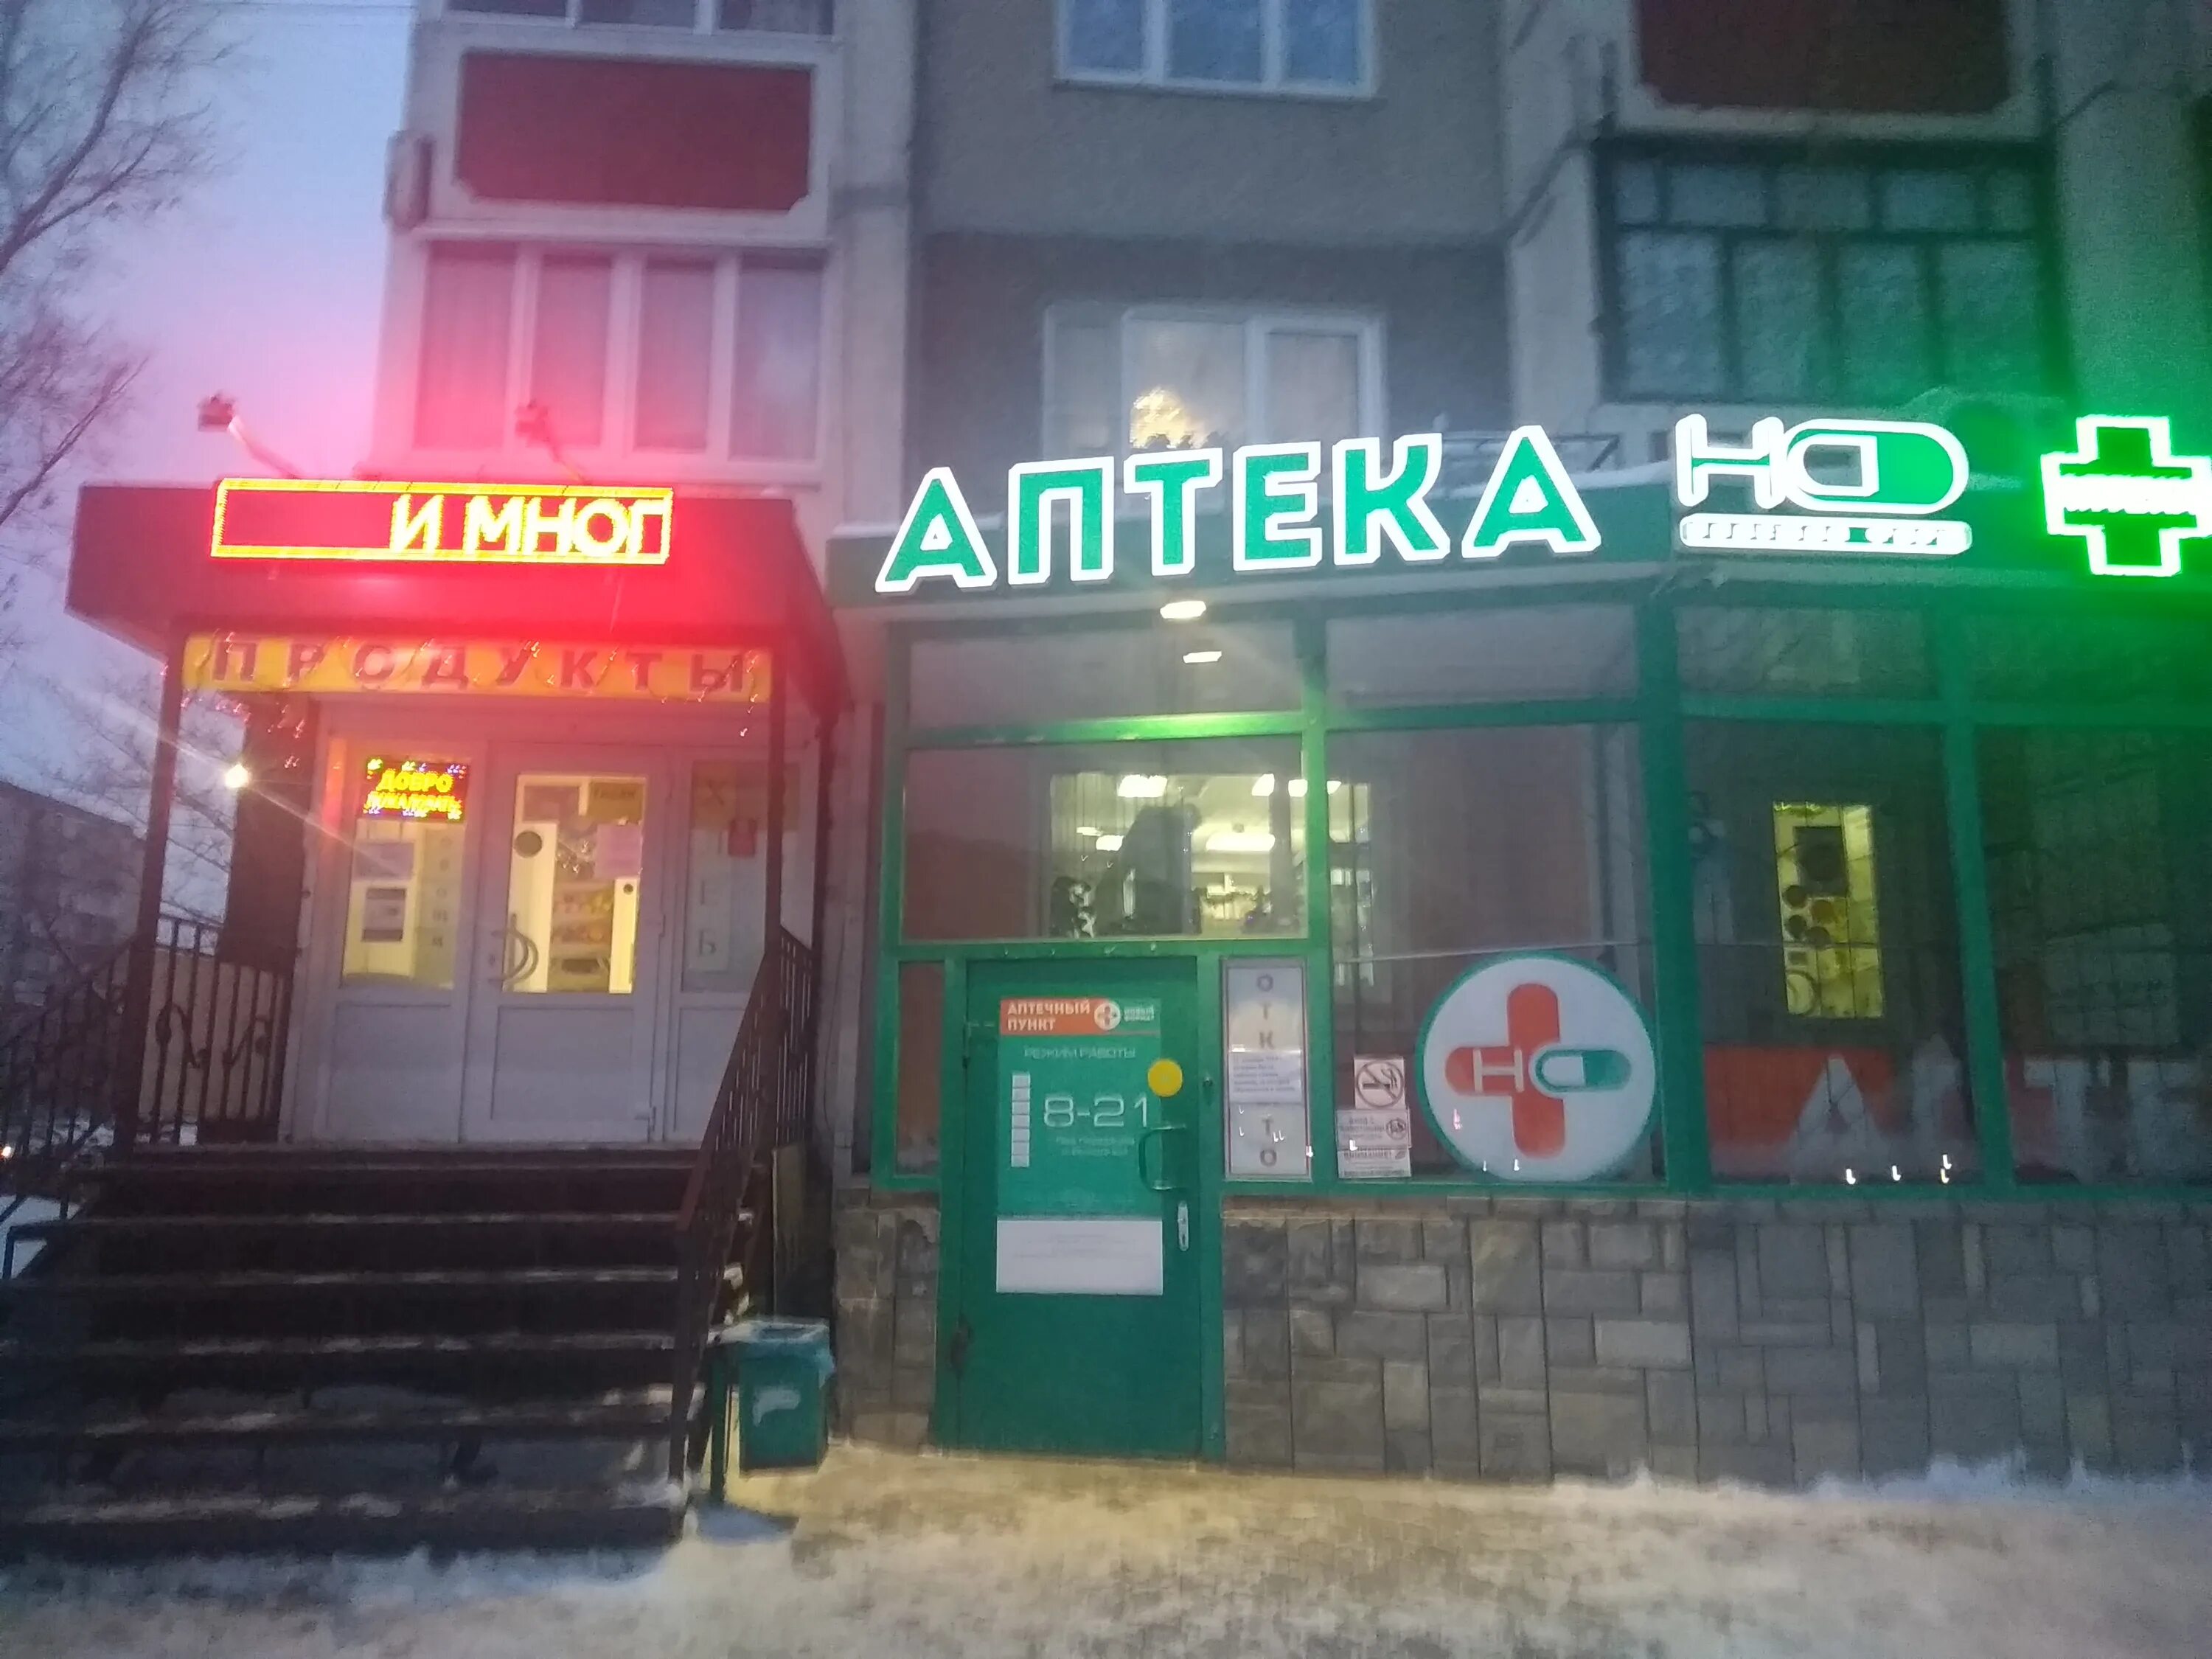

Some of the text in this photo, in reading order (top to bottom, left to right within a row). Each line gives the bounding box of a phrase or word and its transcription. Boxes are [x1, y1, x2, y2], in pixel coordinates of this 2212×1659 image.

[389, 493, 444, 553] И
[875, 424, 1601, 592] АПТЕКА
[212, 639, 743, 693] ПРОДУКТЫ
[376, 769, 453, 793] ДОБРО
[1007, 998, 1091, 1015] АПТЕЧНЫЙ
[1007, 1018, 1056, 1032] ПУНКТ
[1256, 973, 1278, 1167] ОТКТО
[1043, 1094, 1147, 1127] 8-21
